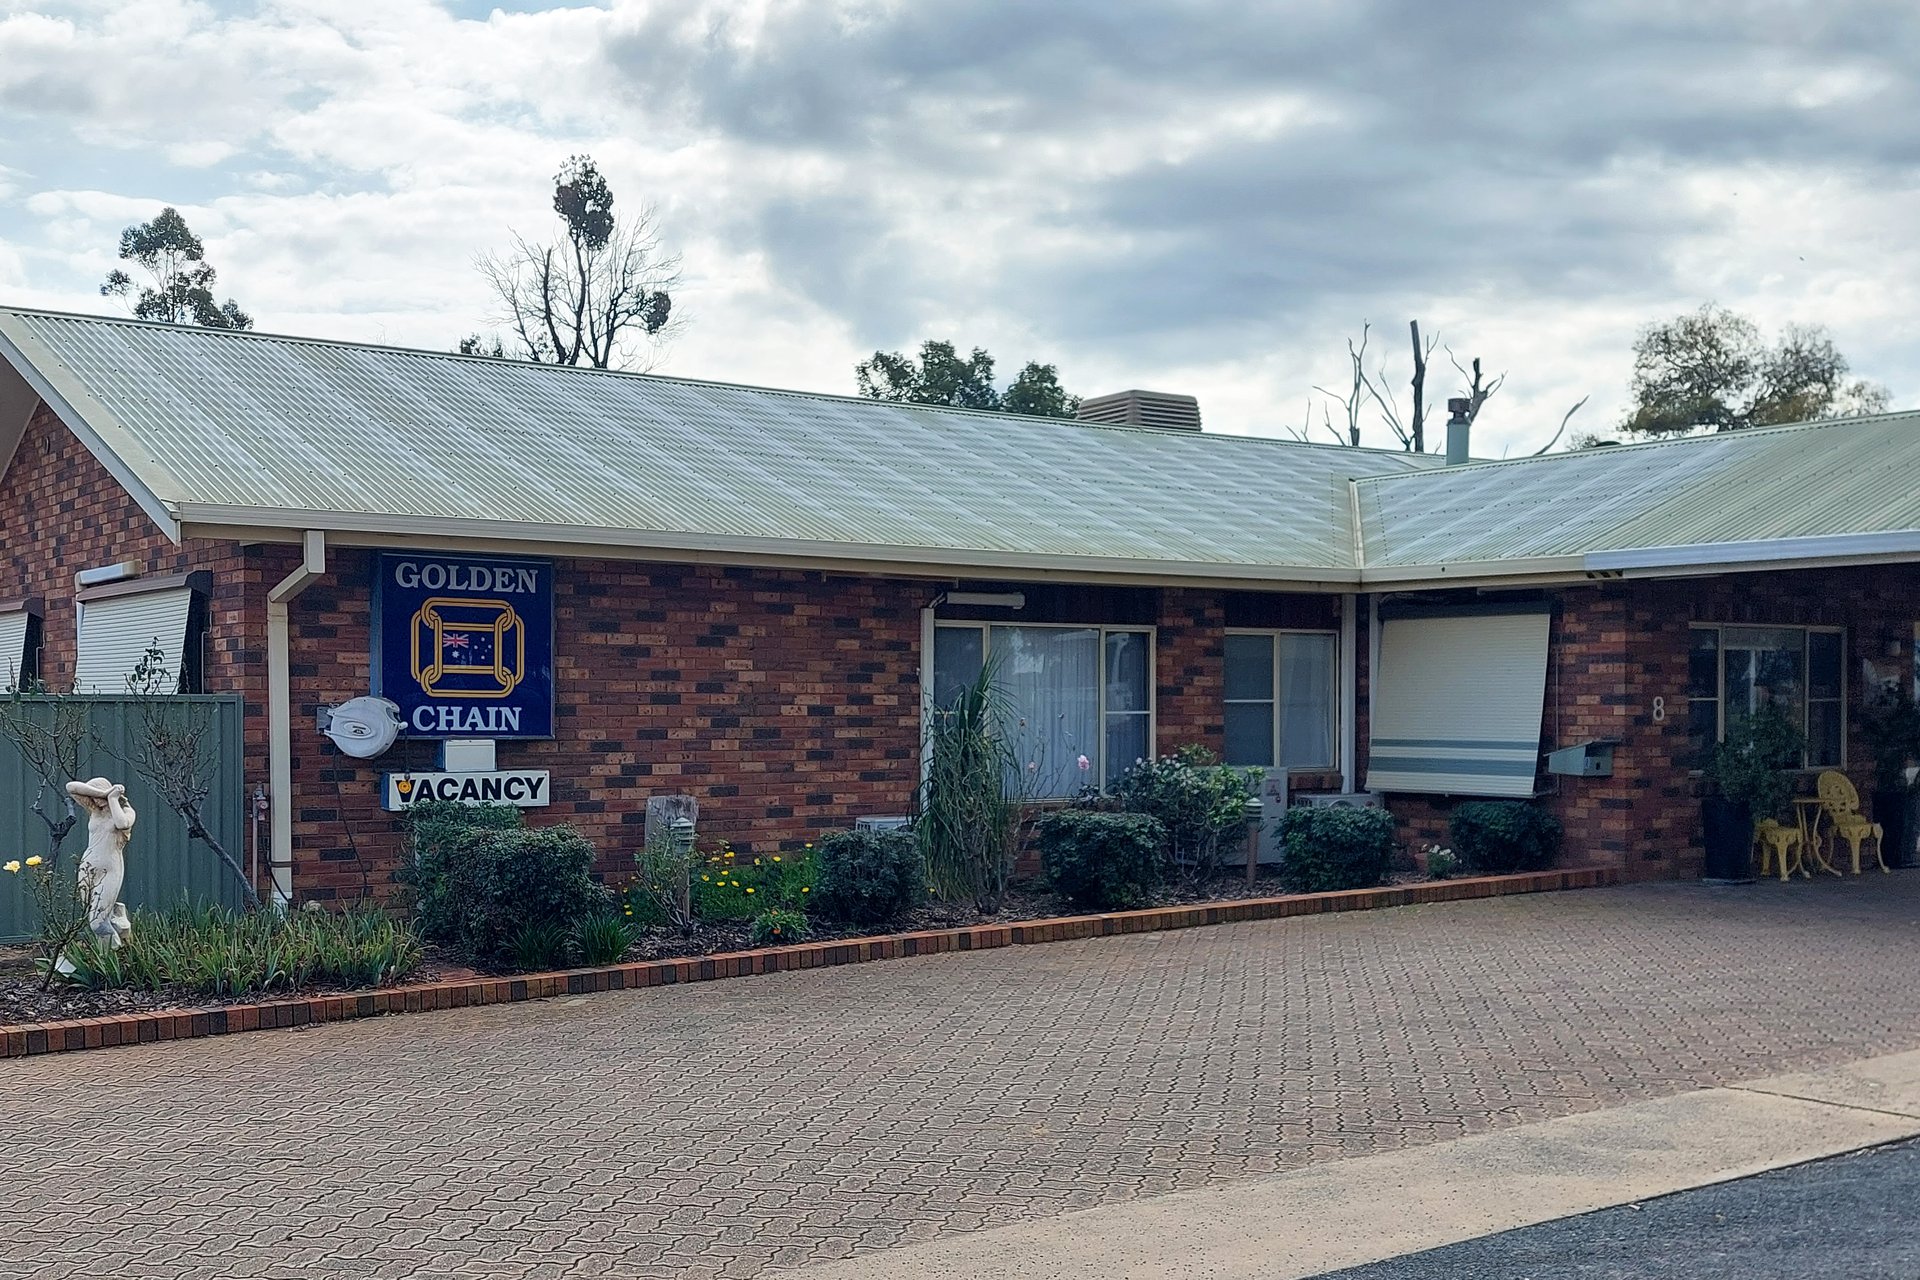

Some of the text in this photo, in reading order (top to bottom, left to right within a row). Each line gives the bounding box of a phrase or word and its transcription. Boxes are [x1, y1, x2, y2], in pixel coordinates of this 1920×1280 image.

[395, 562, 538, 594] GOLDEN
[412, 705, 522, 731] CHAIN
[1653, 696, 1665, 721] 8
[395, 777, 545, 803] VACANCY
